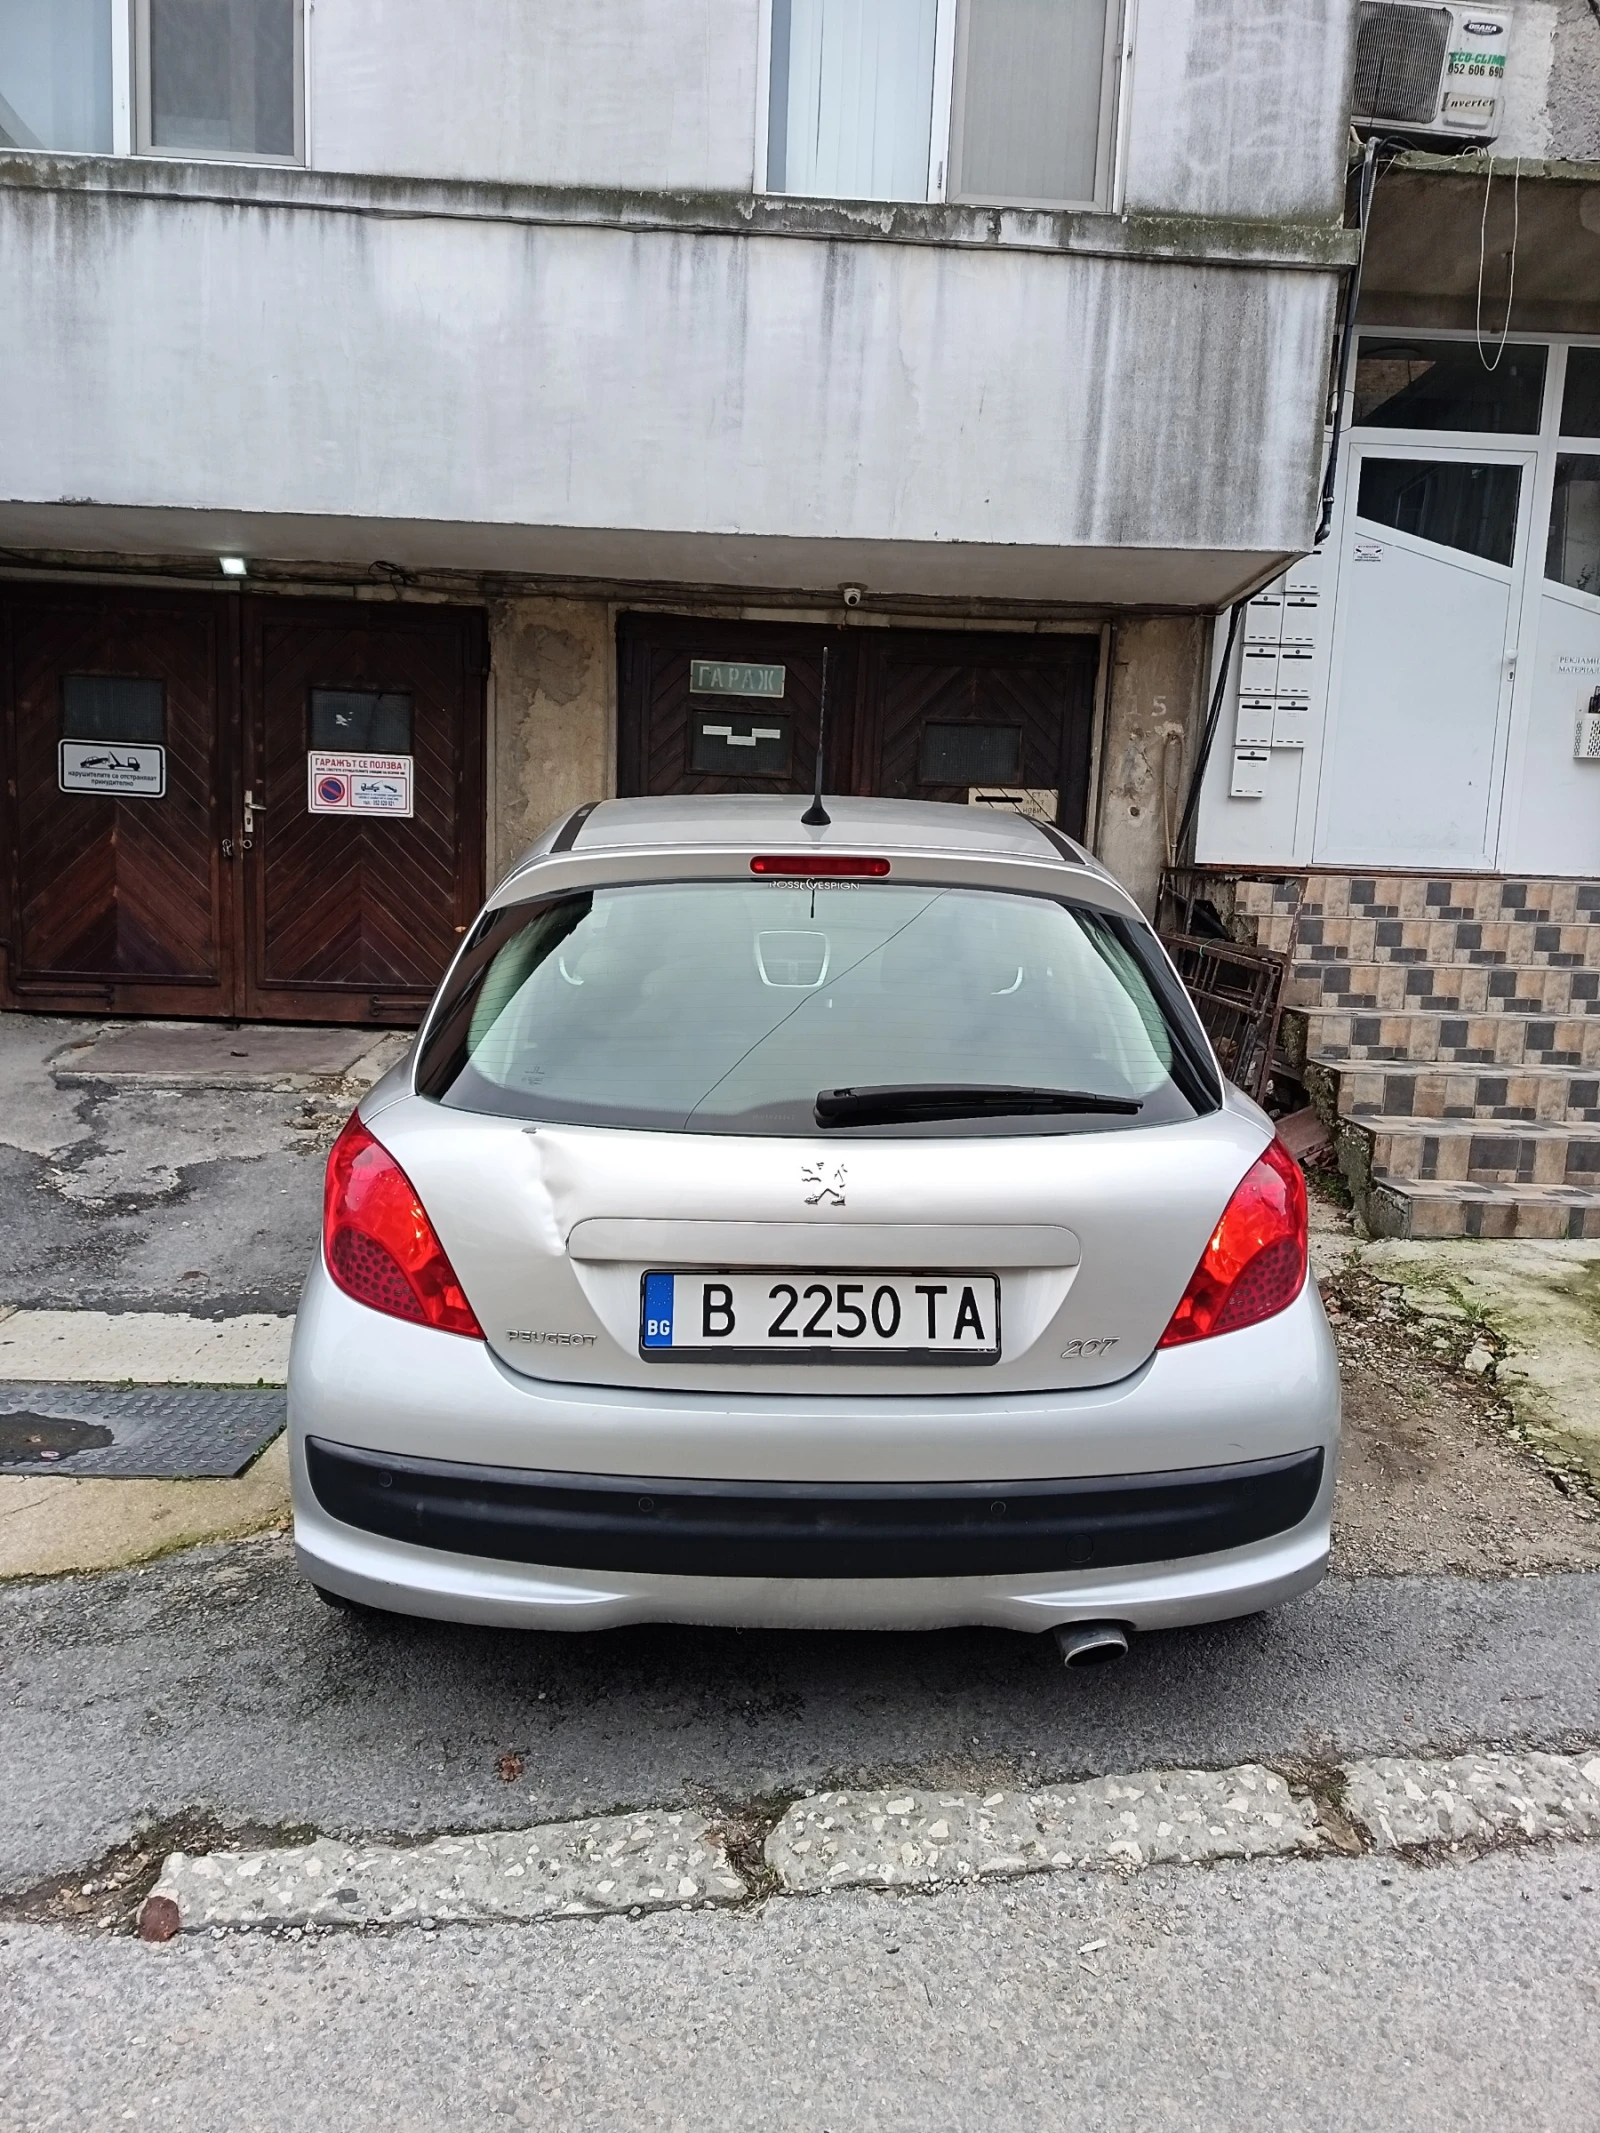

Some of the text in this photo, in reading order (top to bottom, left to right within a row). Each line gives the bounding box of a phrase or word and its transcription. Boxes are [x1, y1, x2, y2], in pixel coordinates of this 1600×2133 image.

[1468, 23, 1497, 32] OSAKA
[1447, 63, 1504, 78] 052 606 690
[698, 666, 775, 691] ГАРАЖ
[315, 757, 358, 768] ГАРАЖЪТ
[358, 760, 368, 768] СЕ
[369, 761, 402, 770] ПОЛЗВА
[647, 1283, 986, 1340] BG B 2250 TA
[506, 1328, 598, 1347] PEUGEOT
[1061, 1336, 1121, 1359] 207
